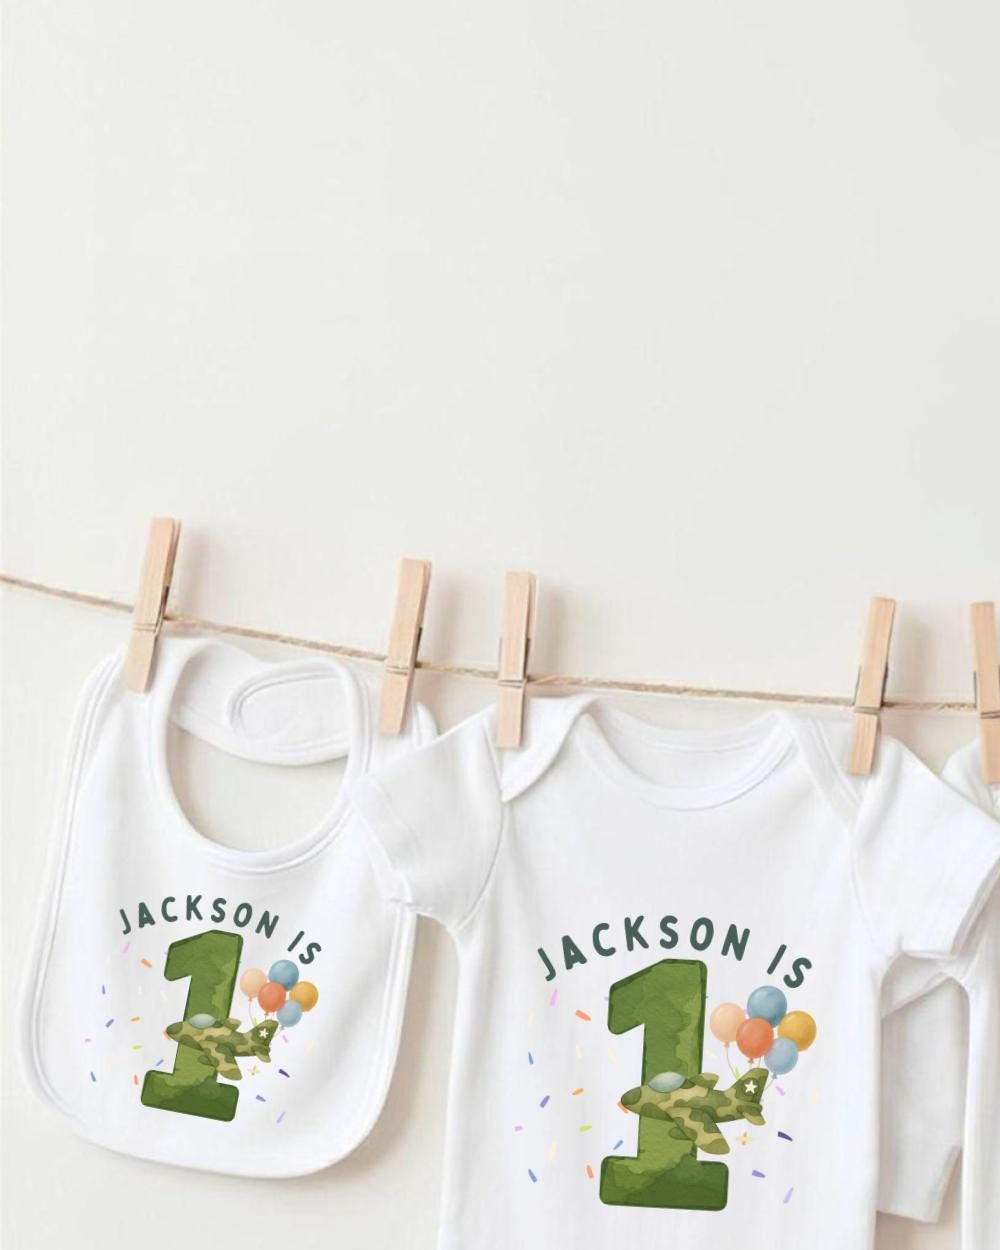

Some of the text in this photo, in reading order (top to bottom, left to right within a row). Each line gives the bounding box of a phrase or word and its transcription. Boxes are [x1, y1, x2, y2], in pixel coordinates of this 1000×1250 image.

[119, 895, 322, 966] JACKSON IS
[537, 915, 813, 989] JACKSON IS
[141, 930, 243, 1121] 1
[600, 958, 729, 1211] 1
